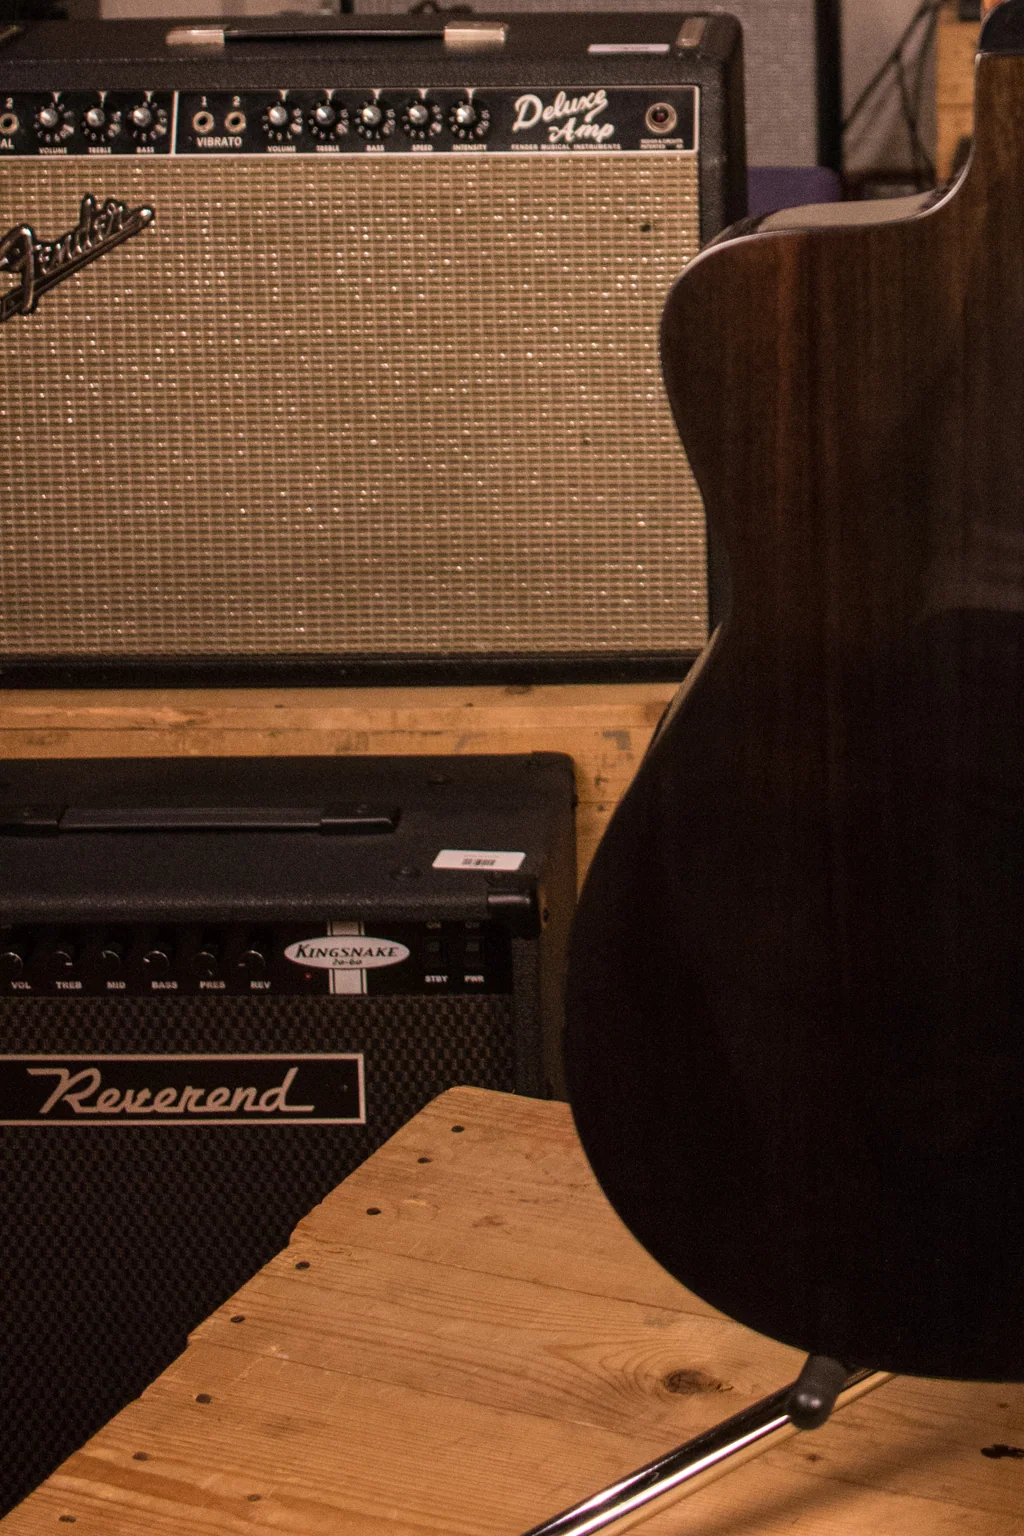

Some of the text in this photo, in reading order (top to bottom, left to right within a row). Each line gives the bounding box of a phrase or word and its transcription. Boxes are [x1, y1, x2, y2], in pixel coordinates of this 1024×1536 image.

[512, 89, 608, 132] Deluxe
[548, 117, 615, 143] Amp
[196, 136, 242, 147] VIBRATO
[267, 145, 296, 153] VOLUME
[295, 943, 400, 958] KINGSNAKE
[11, 981, 31, 989] VOL
[56, 981, 82, 989] TREB
[107, 981, 126, 989] MID
[152, 981, 178, 989] BASS
[200, 981, 226, 989] PRES
[251, 981, 271, 989] REV
[27, 1067, 315, 1113] Reverend
